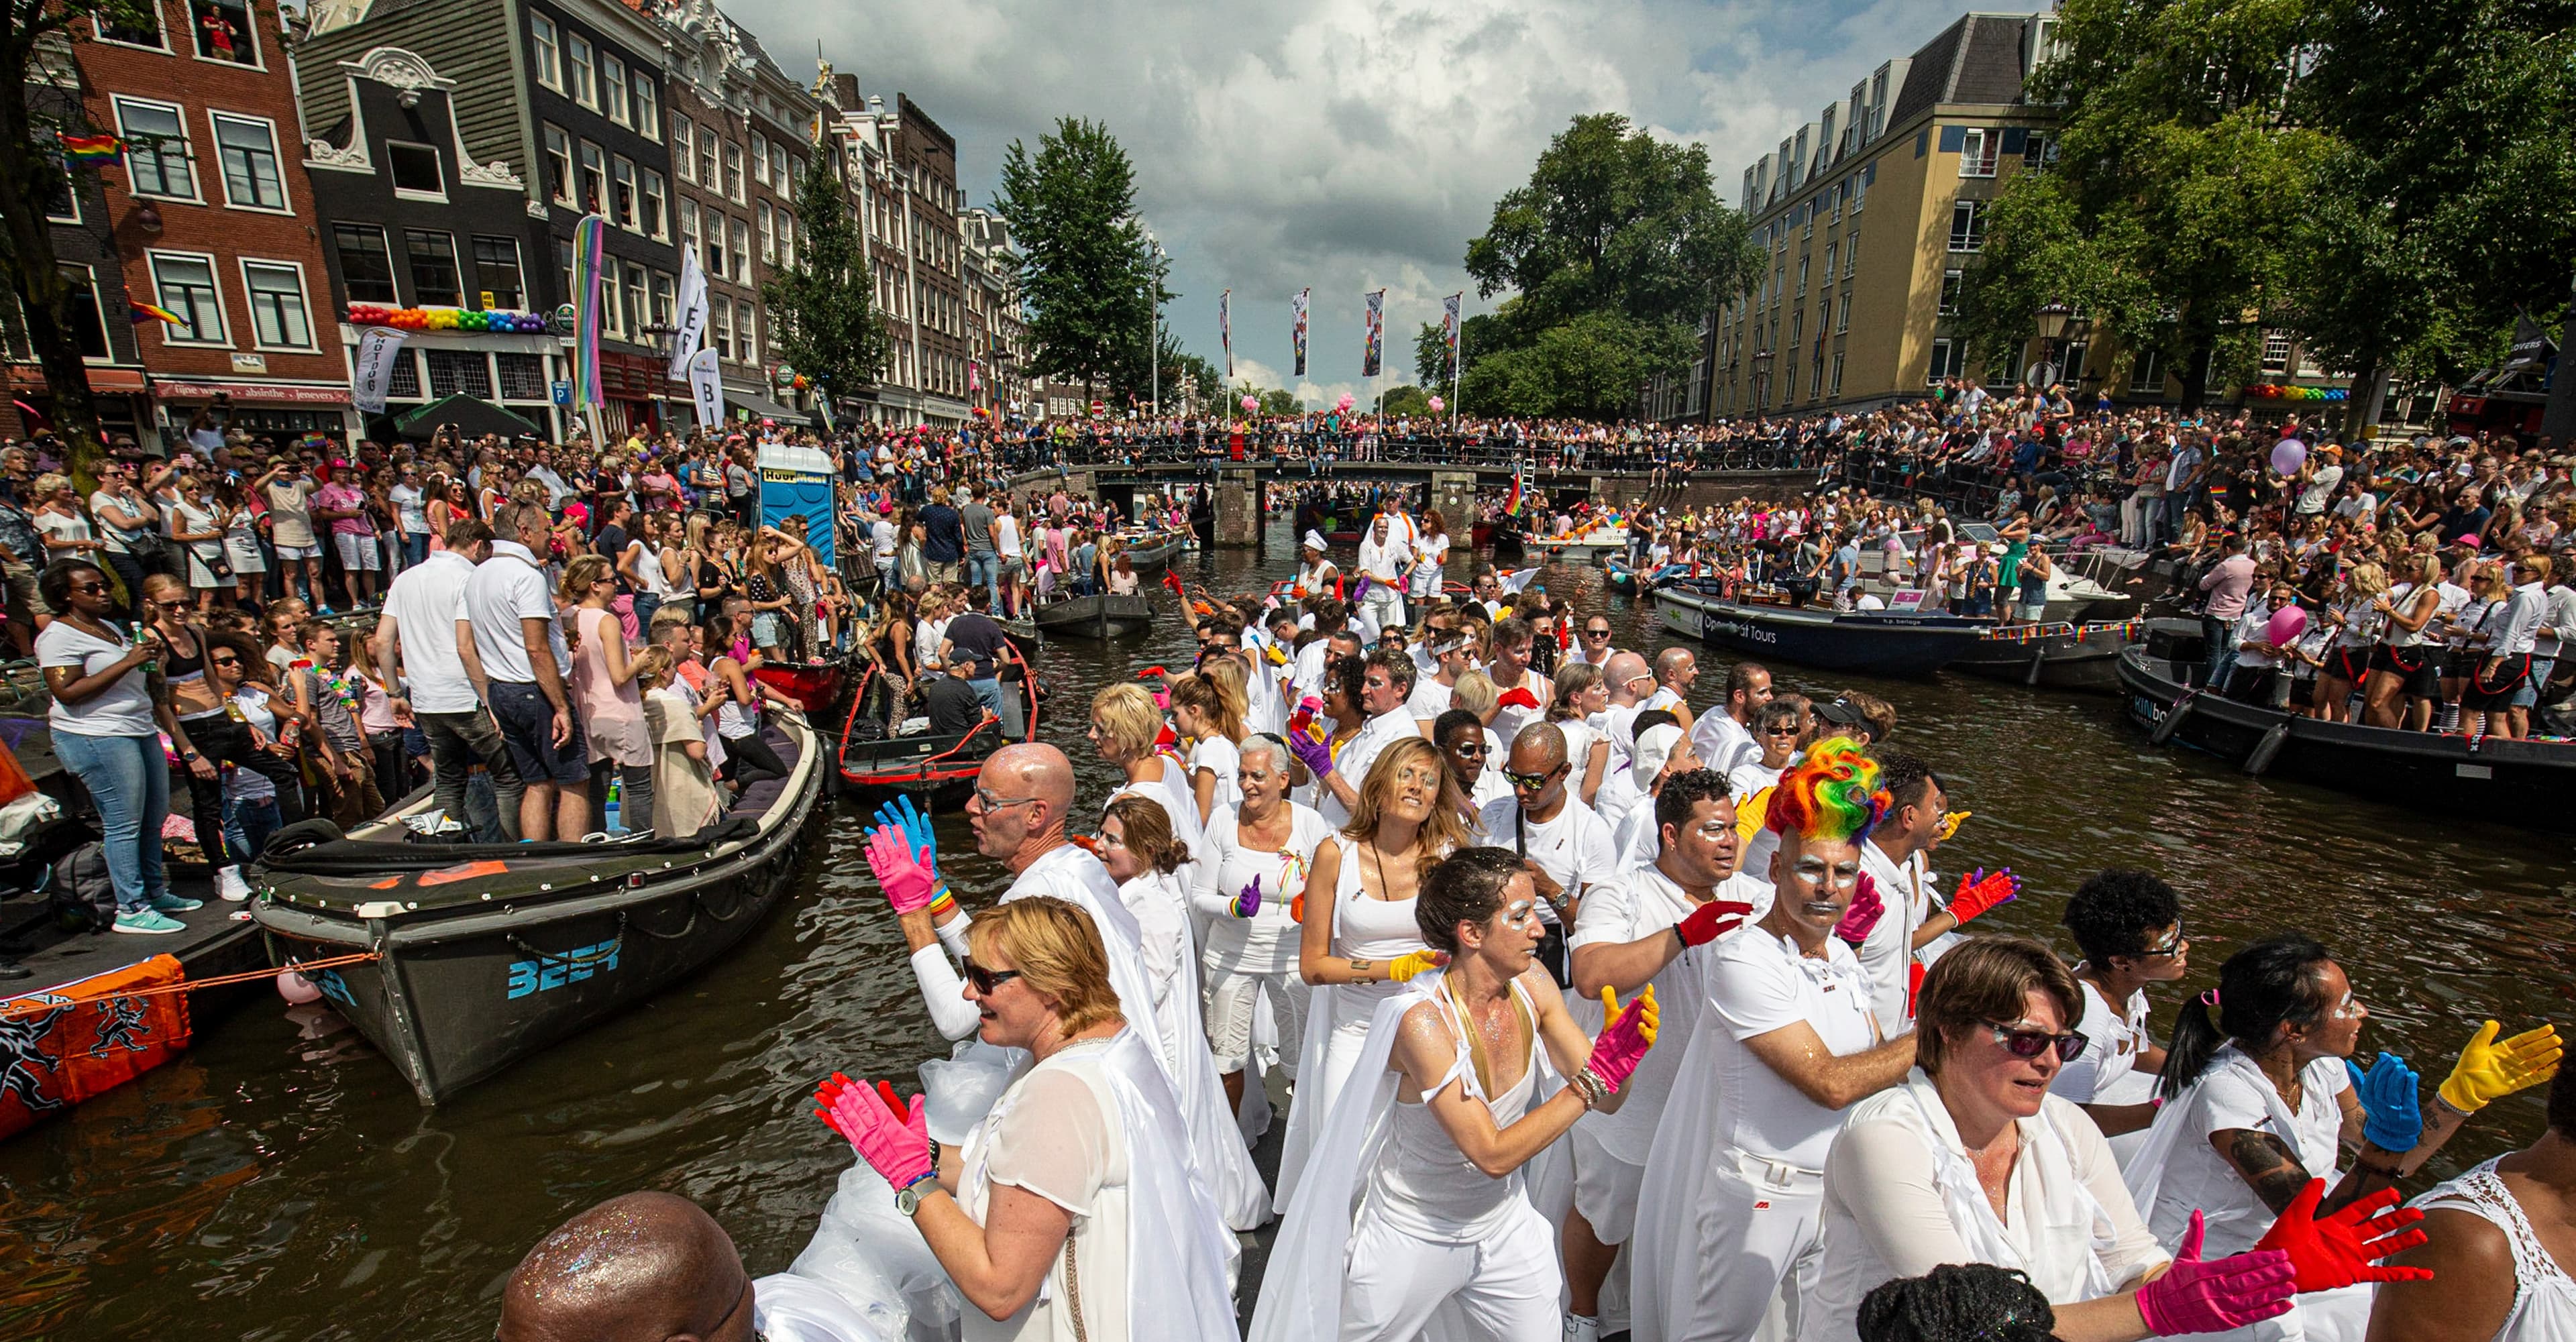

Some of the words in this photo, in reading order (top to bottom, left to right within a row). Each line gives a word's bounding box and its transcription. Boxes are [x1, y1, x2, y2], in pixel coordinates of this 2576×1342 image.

[245, 388, 285, 398] absinthe
[296, 389, 334, 400] jenevers
[557, 389, 564, 402] P
[1751, 626, 1776, 643] Tours
[2135, 695, 2167, 722] KINbo
[508, 939, 622, 999] BEER
